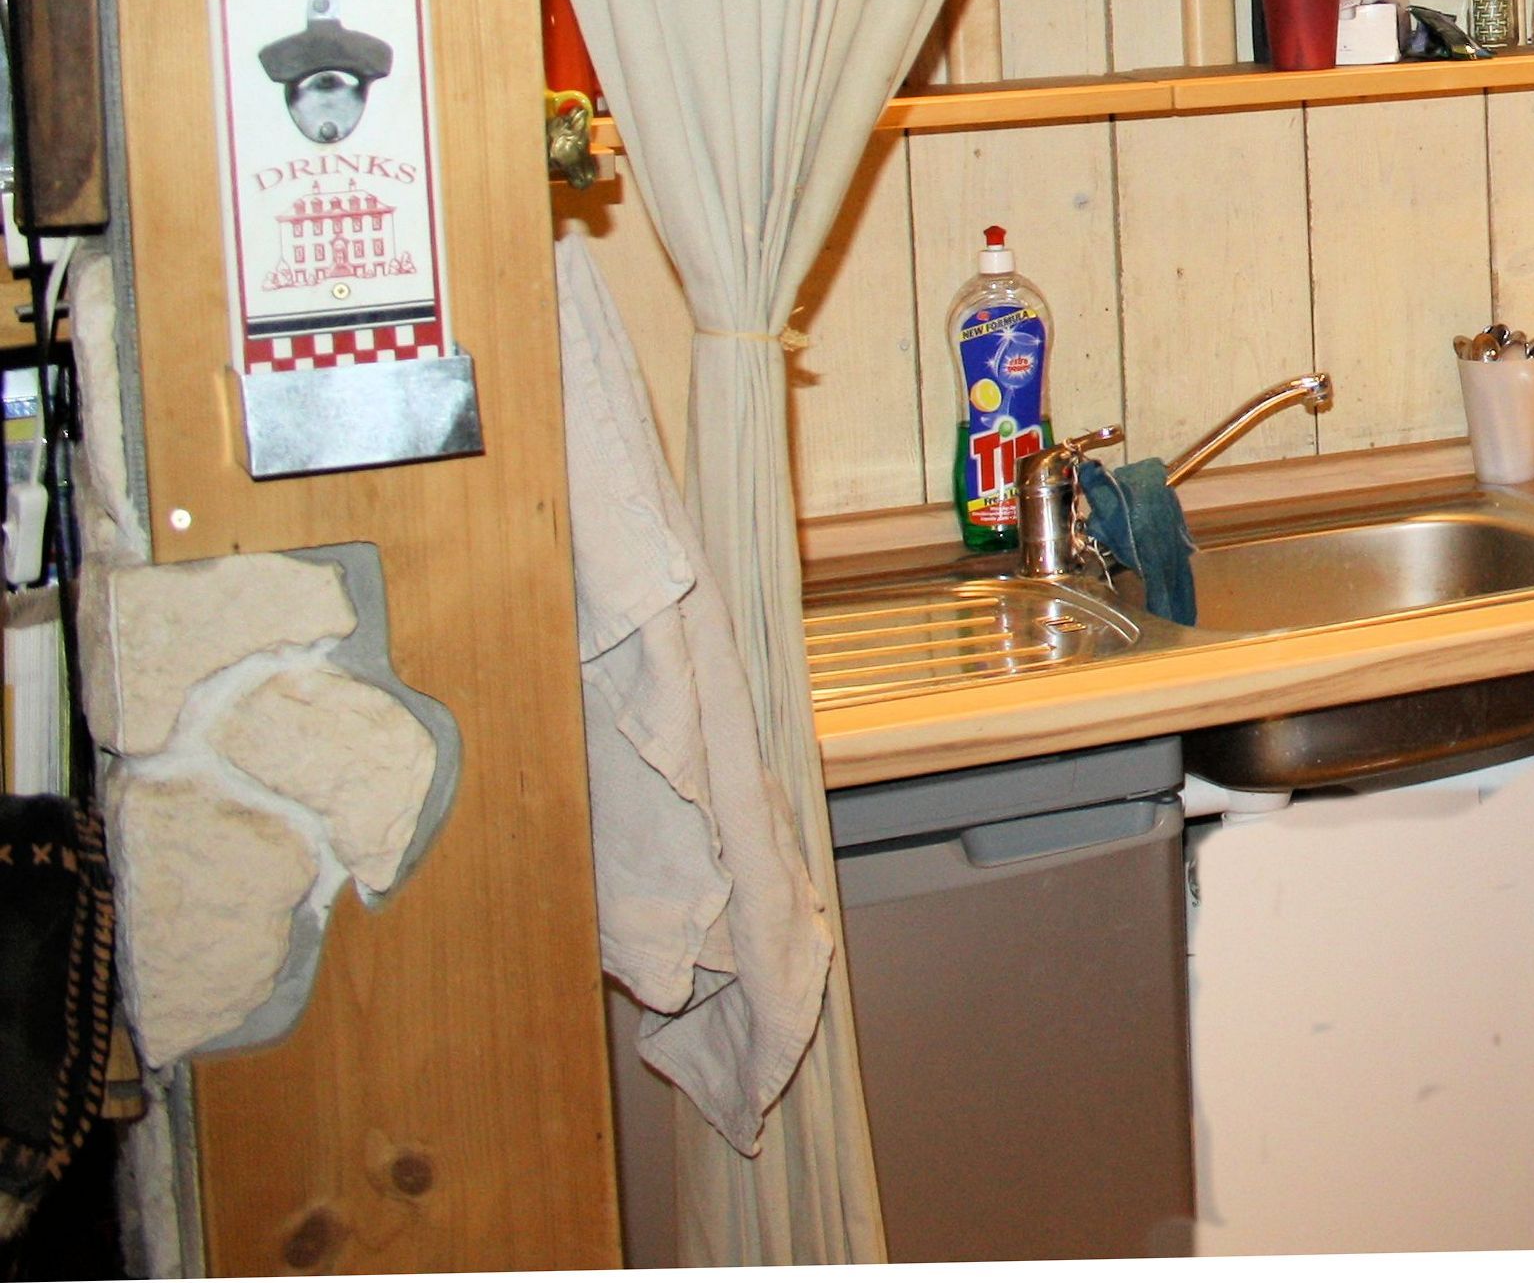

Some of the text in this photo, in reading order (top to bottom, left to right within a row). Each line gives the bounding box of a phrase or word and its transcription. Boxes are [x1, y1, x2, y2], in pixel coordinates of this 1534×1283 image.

[254, 154, 417, 192] DRINKS
[962, 309, 1029, 340] NEW FORMULA
